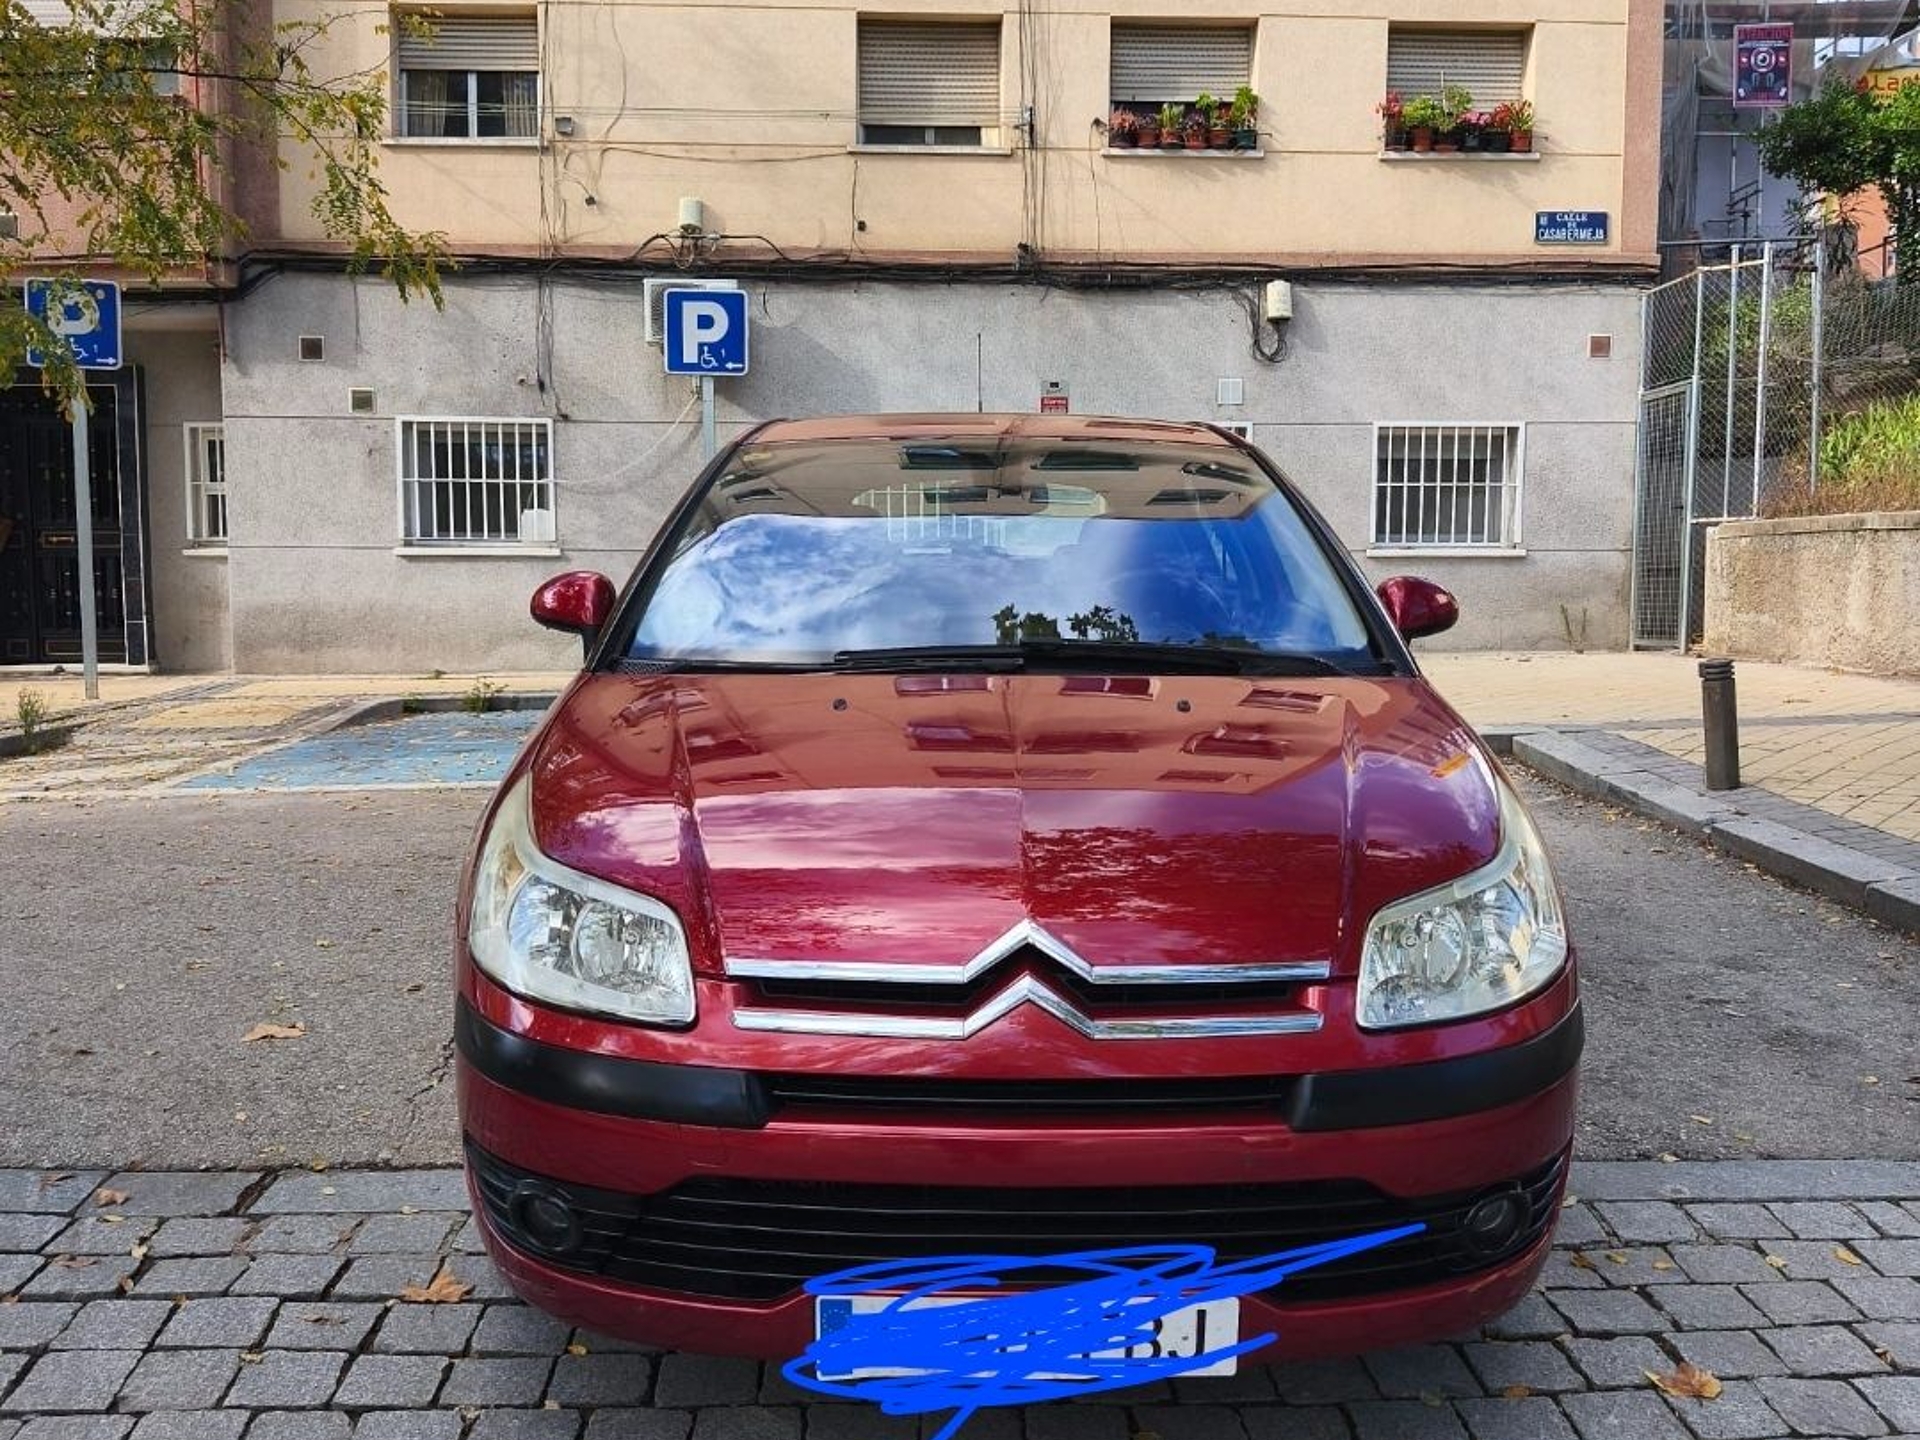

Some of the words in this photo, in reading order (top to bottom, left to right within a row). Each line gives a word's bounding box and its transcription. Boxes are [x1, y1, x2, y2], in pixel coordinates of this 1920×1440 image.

[1556, 213, 1588, 221] CALLE
[1539, 228, 1604, 240] CASABERMEJA
[682, 301, 729, 363] P
